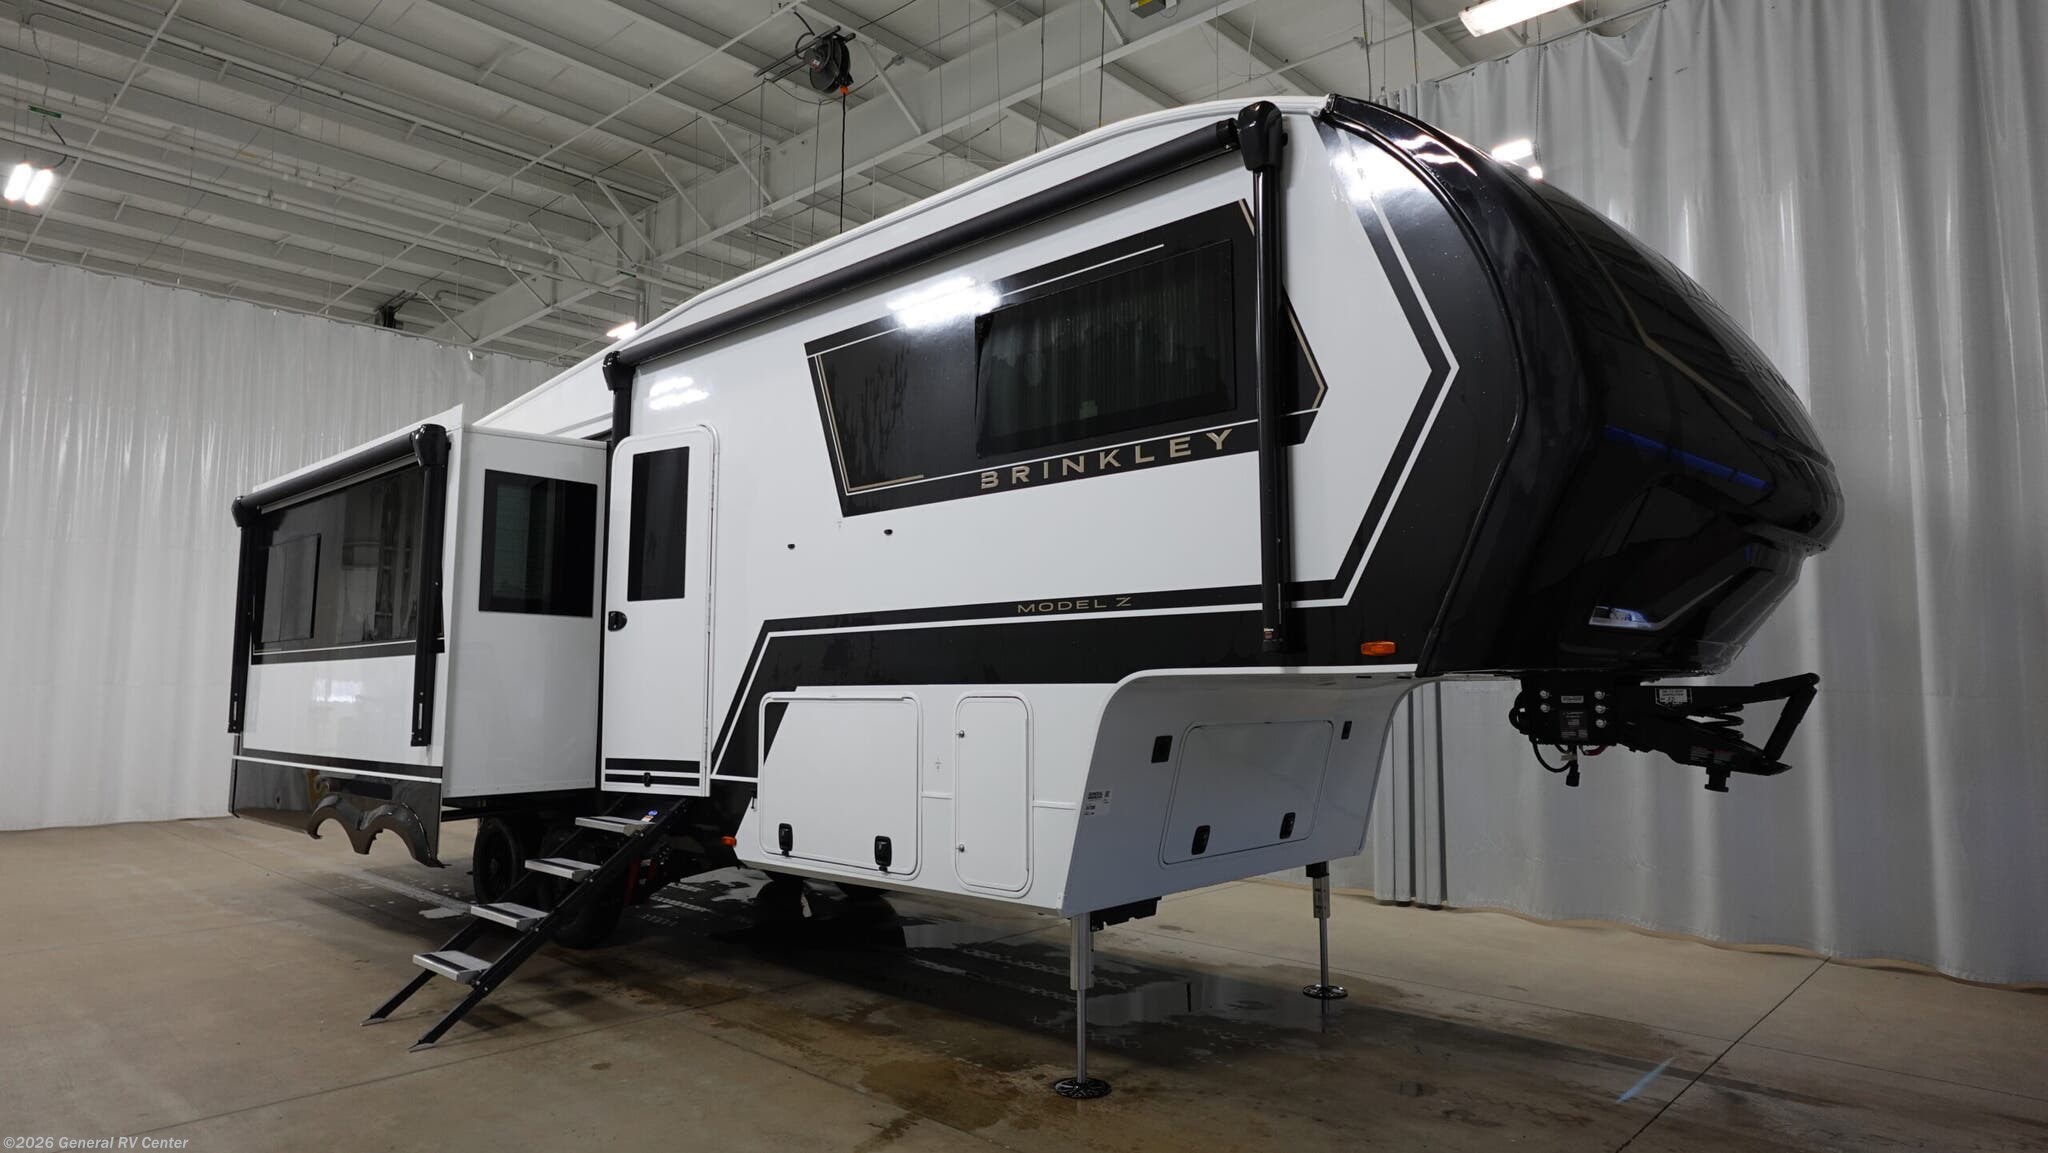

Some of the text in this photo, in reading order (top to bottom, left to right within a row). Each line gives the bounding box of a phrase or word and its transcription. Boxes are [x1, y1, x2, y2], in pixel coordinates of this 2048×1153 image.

[981, 428, 1233, 490] BRINKLEY
[1017, 596, 1132, 614] MODEL Z
